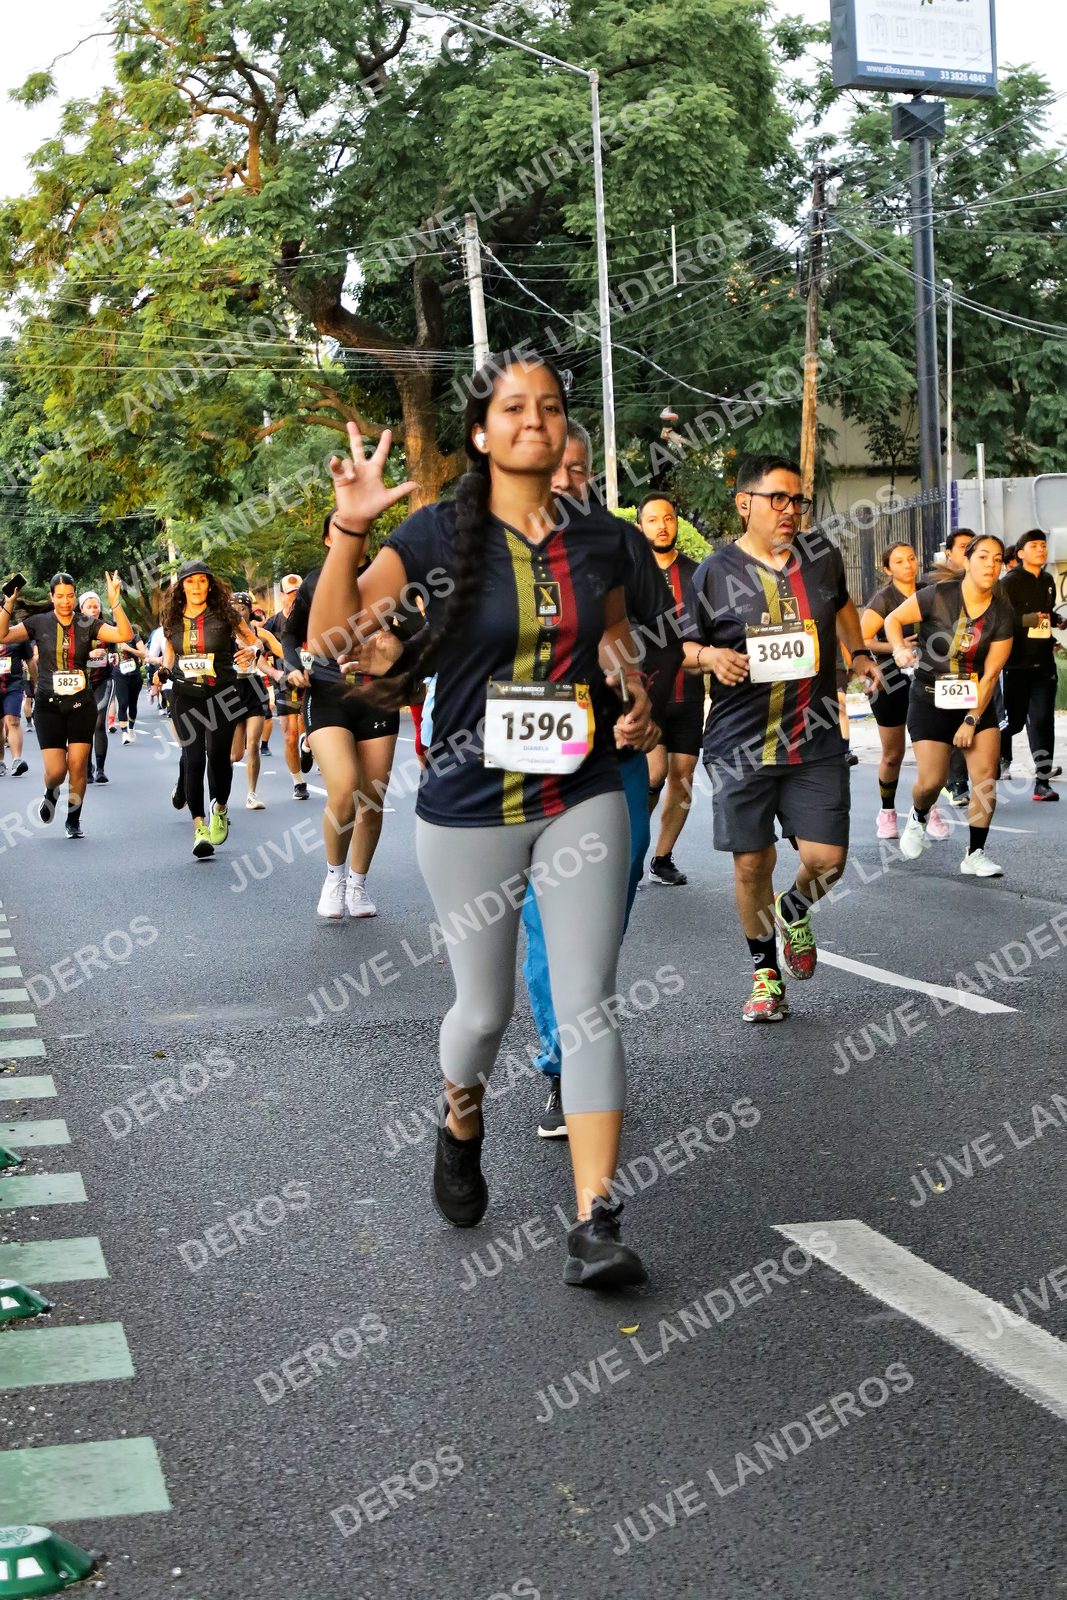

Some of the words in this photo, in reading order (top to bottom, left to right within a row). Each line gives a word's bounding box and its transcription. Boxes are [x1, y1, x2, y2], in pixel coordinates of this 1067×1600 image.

[940, 70, 950, 80] 33
[951, 71, 968, 82] 3826
[969, 73, 987, 83] 4845
[758, 639, 804, 662] 3840
[57, 678, 79, 687] 5825
[941, 684, 970, 695] 5621
[502, 712, 574, 741] 1596
